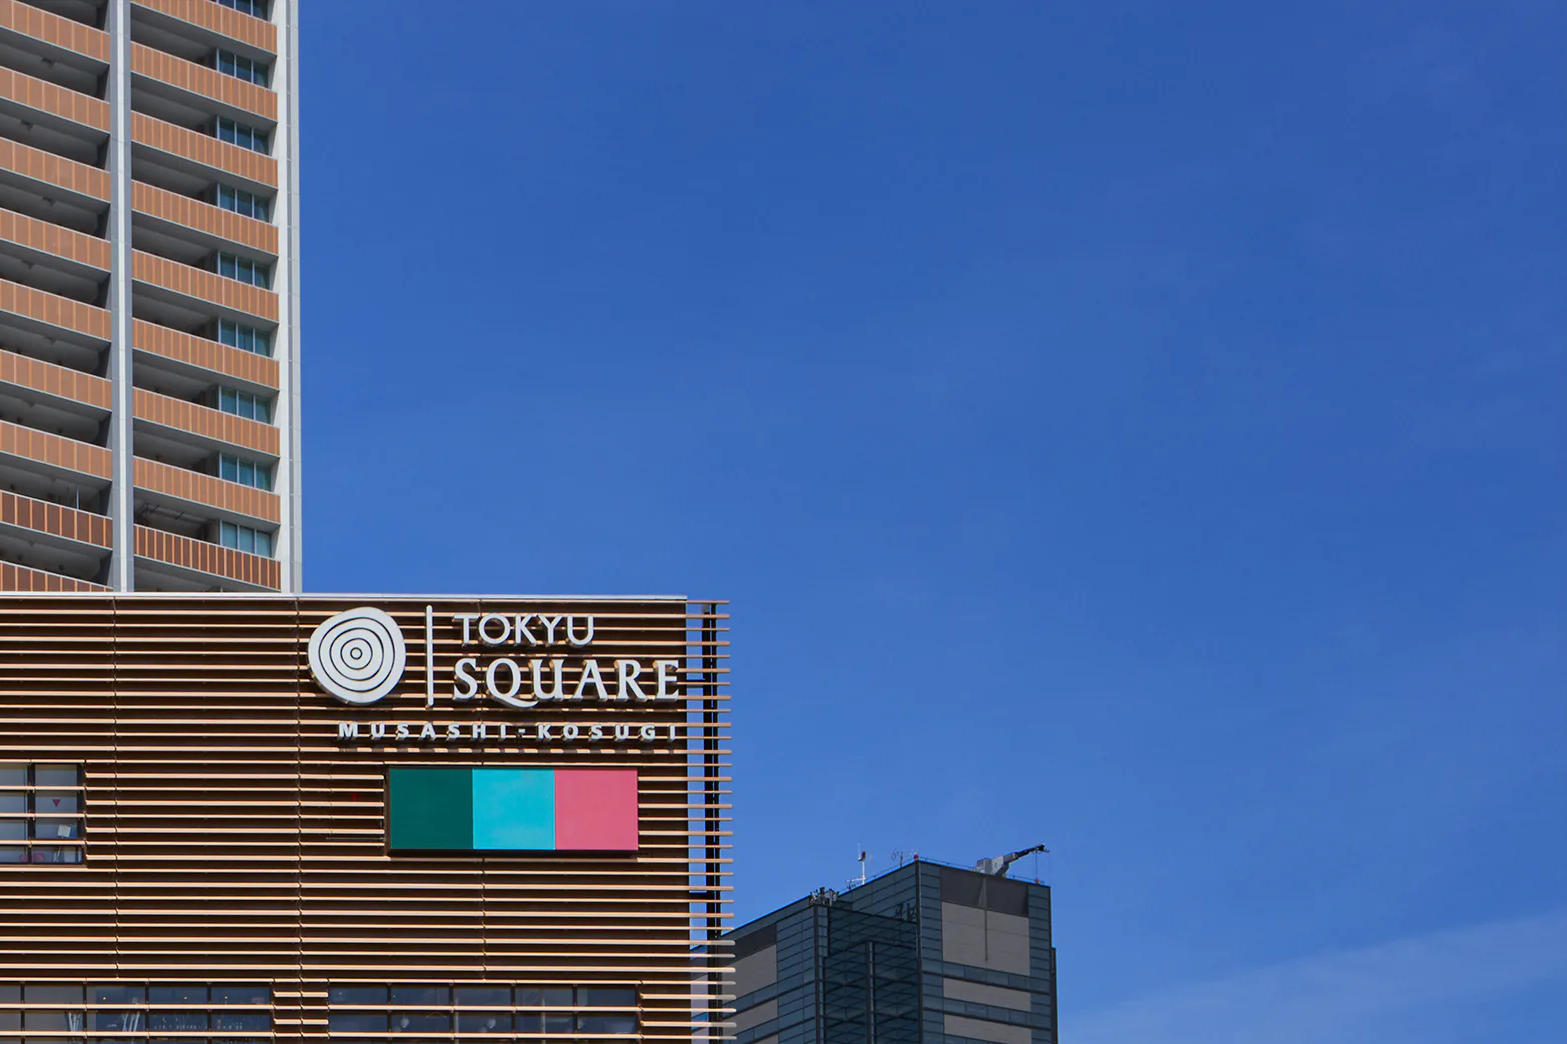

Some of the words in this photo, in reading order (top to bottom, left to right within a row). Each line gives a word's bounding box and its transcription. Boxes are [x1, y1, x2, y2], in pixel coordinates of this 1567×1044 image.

[453, 613, 594, 645] TOKYU
[453, 658, 680, 708] SQUARE
[338, 722, 677, 741] MUSASHI-KOSUGI
